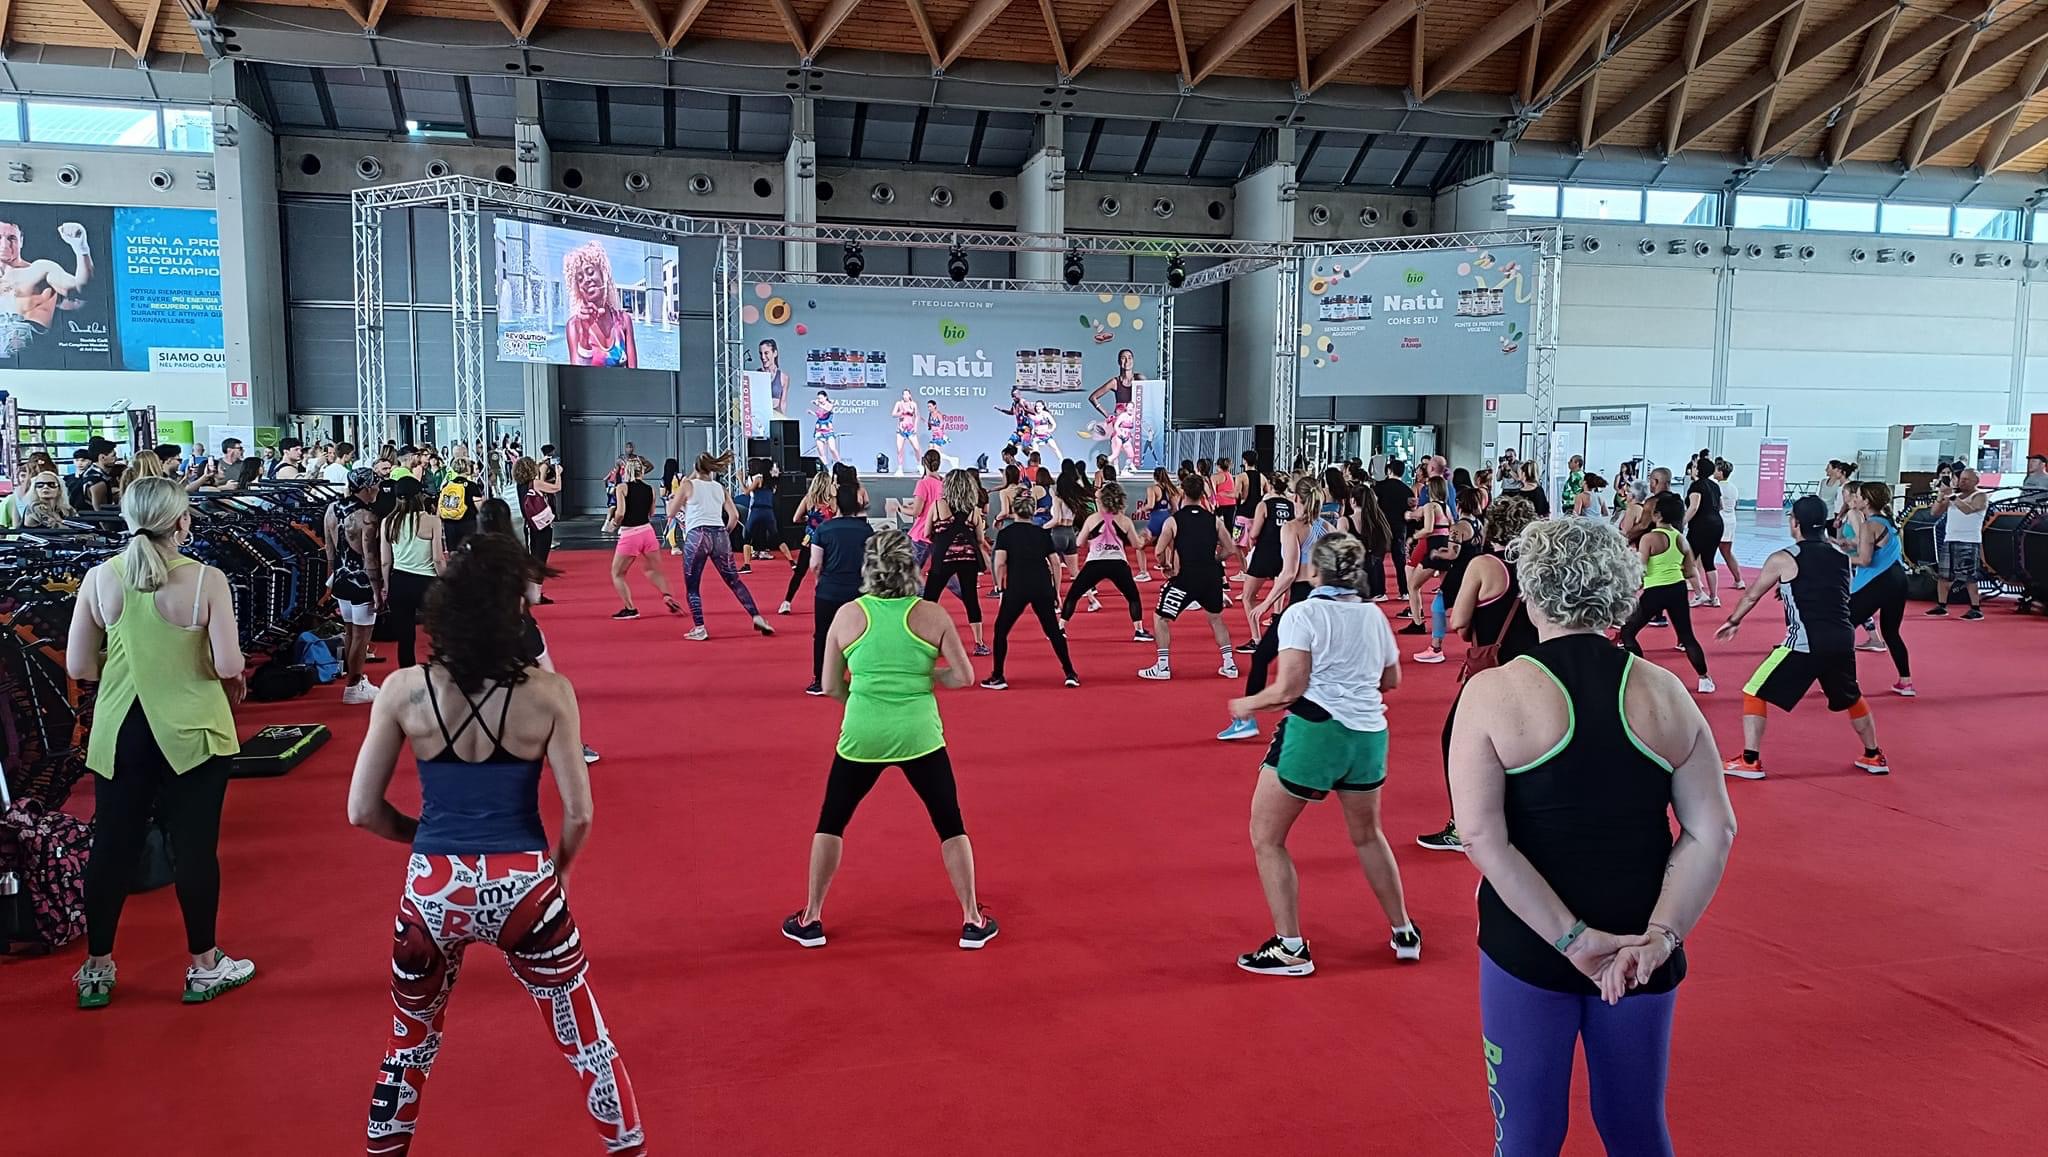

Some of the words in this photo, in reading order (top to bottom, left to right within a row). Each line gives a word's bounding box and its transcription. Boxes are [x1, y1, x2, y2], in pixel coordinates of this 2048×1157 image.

[126, 236, 167, 246] VIENI
[172, 238, 183, 246] A
[188, 238, 220, 247] PRO
[127, 246, 220, 256] GRATUITAM
[127, 256, 194, 266] L'ACQUA
[128, 266, 154, 275] DEI
[158, 267, 220, 277] CAMPIO
[1407, 273, 1424, 283] bio
[130, 288, 157, 296] POTRAI
[158, 289, 192, 297] RIEMPIRE
[912, 300, 983, 308] FITEDUCATION
[1383, 289, 1444, 312] Natù
[1387, 317, 1412, 325] COME
[1413, 316, 1425, 324] SEI
[1427, 316, 1439, 324] TU
[505, 332, 547, 341] REVOLUTION
[943, 325, 965, 339] bio
[159, 352, 200, 363] SIAMO
[912, 349, 993, 377] Natù
[919, 386, 951, 396] COME
[954, 387, 969, 396] SEI
[972, 387, 987, 396] TU
[1161, 586, 1187, 618] KLEIN
[479, 881, 516, 906] MY
[422, 900, 443, 914] LIPS
